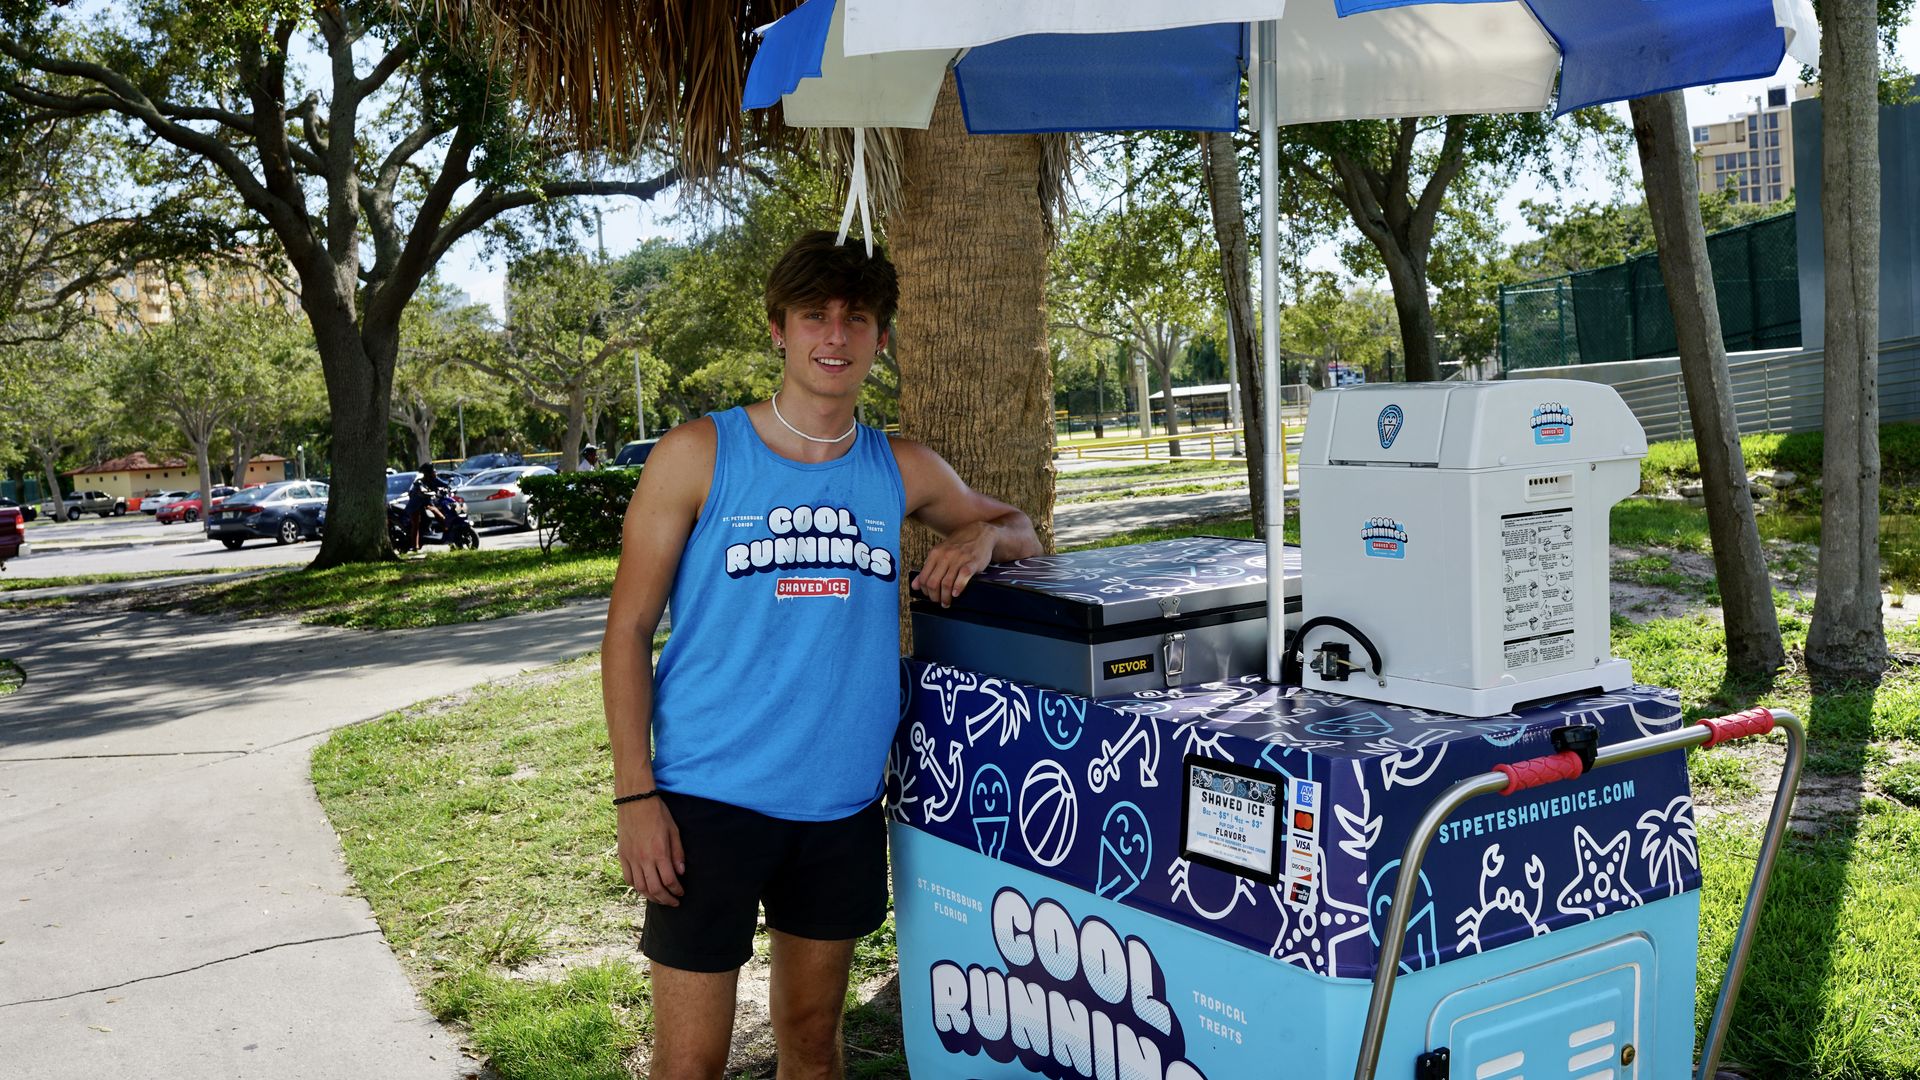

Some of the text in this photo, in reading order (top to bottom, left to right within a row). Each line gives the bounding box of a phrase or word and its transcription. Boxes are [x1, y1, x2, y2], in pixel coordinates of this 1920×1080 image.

[1540, 402, 1563, 414] COOL
[1530, 413, 1573, 429] RUNNINGS
[767, 504, 860, 537] COOL
[1371, 517, 1396, 529] COOL
[1361, 528, 1408, 543] RUNNINGS
[725, 536, 894, 577] RUNNINGS
[778, 582, 847, 593] SHAVED ICE
[1111, 659, 1147, 674] VEVOR
[1301, 785, 1313, 796] AM
[1201, 791, 1265, 817] SHAVED ICE
[1439, 780, 1636, 844] STPETESHAVEDICE.COM
[1215, 827, 1246, 842] FLAVORS
[1295, 839, 1311, 850] VISA
[1291, 862, 1311, 872] DISCOVER
[917, 877, 983, 913] ST. PETERSBURG
[934, 901, 968, 925] FLORIDA
[991, 887, 1173, 1037] COOL
[1192, 990, 1249, 1025] TROPICAL
[931, 960, 1206, 1080] RUNNIN
[1199, 1014, 1243, 1045] TREATS
